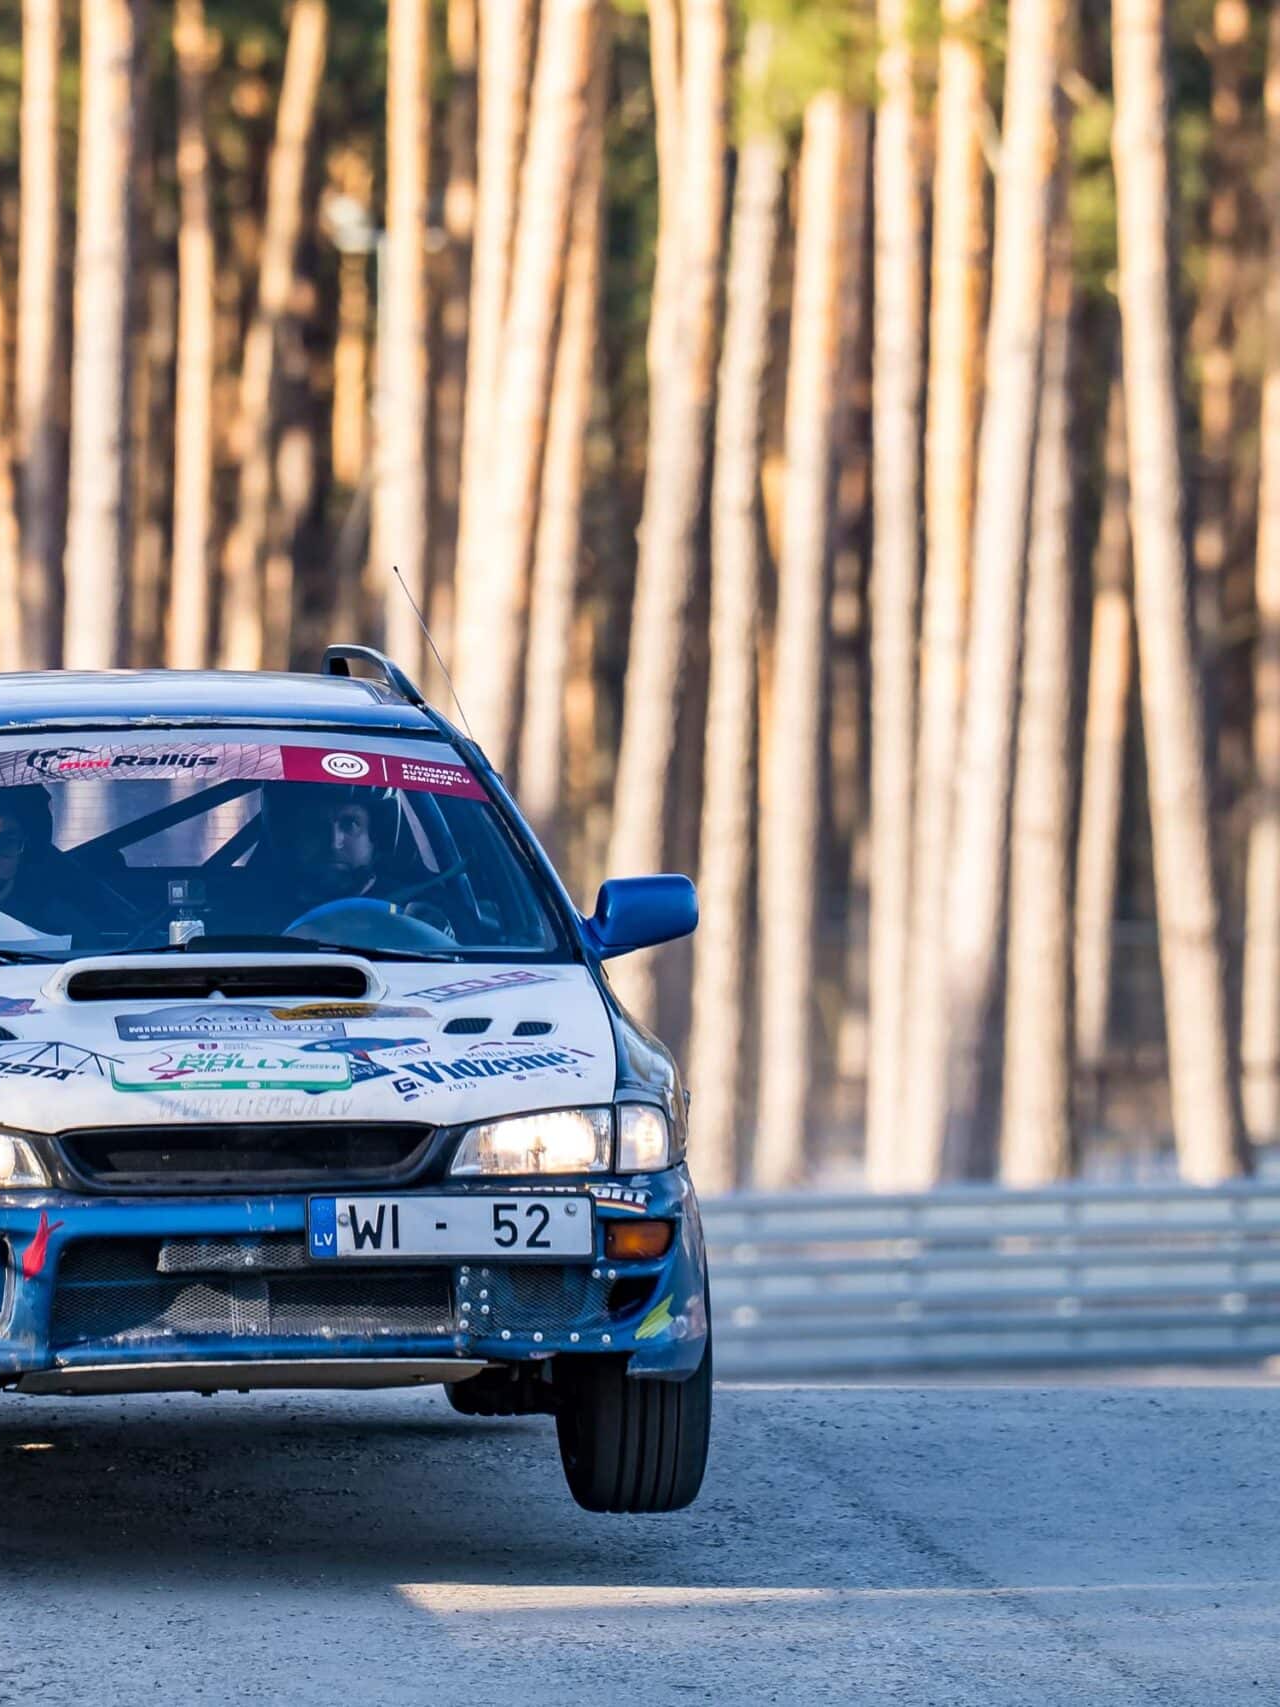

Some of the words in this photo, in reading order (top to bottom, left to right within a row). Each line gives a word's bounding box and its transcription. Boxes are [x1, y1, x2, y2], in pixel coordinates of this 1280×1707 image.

[401, 763, 463, 777] STANDARTA
[176, 1057, 302, 1070] RALLY
[398, 1051, 579, 1084] Vidzeme
[348, 1203, 401, 1249] WI
[492, 1203, 552, 1249] 52
[314, 1233, 334, 1247] LV
